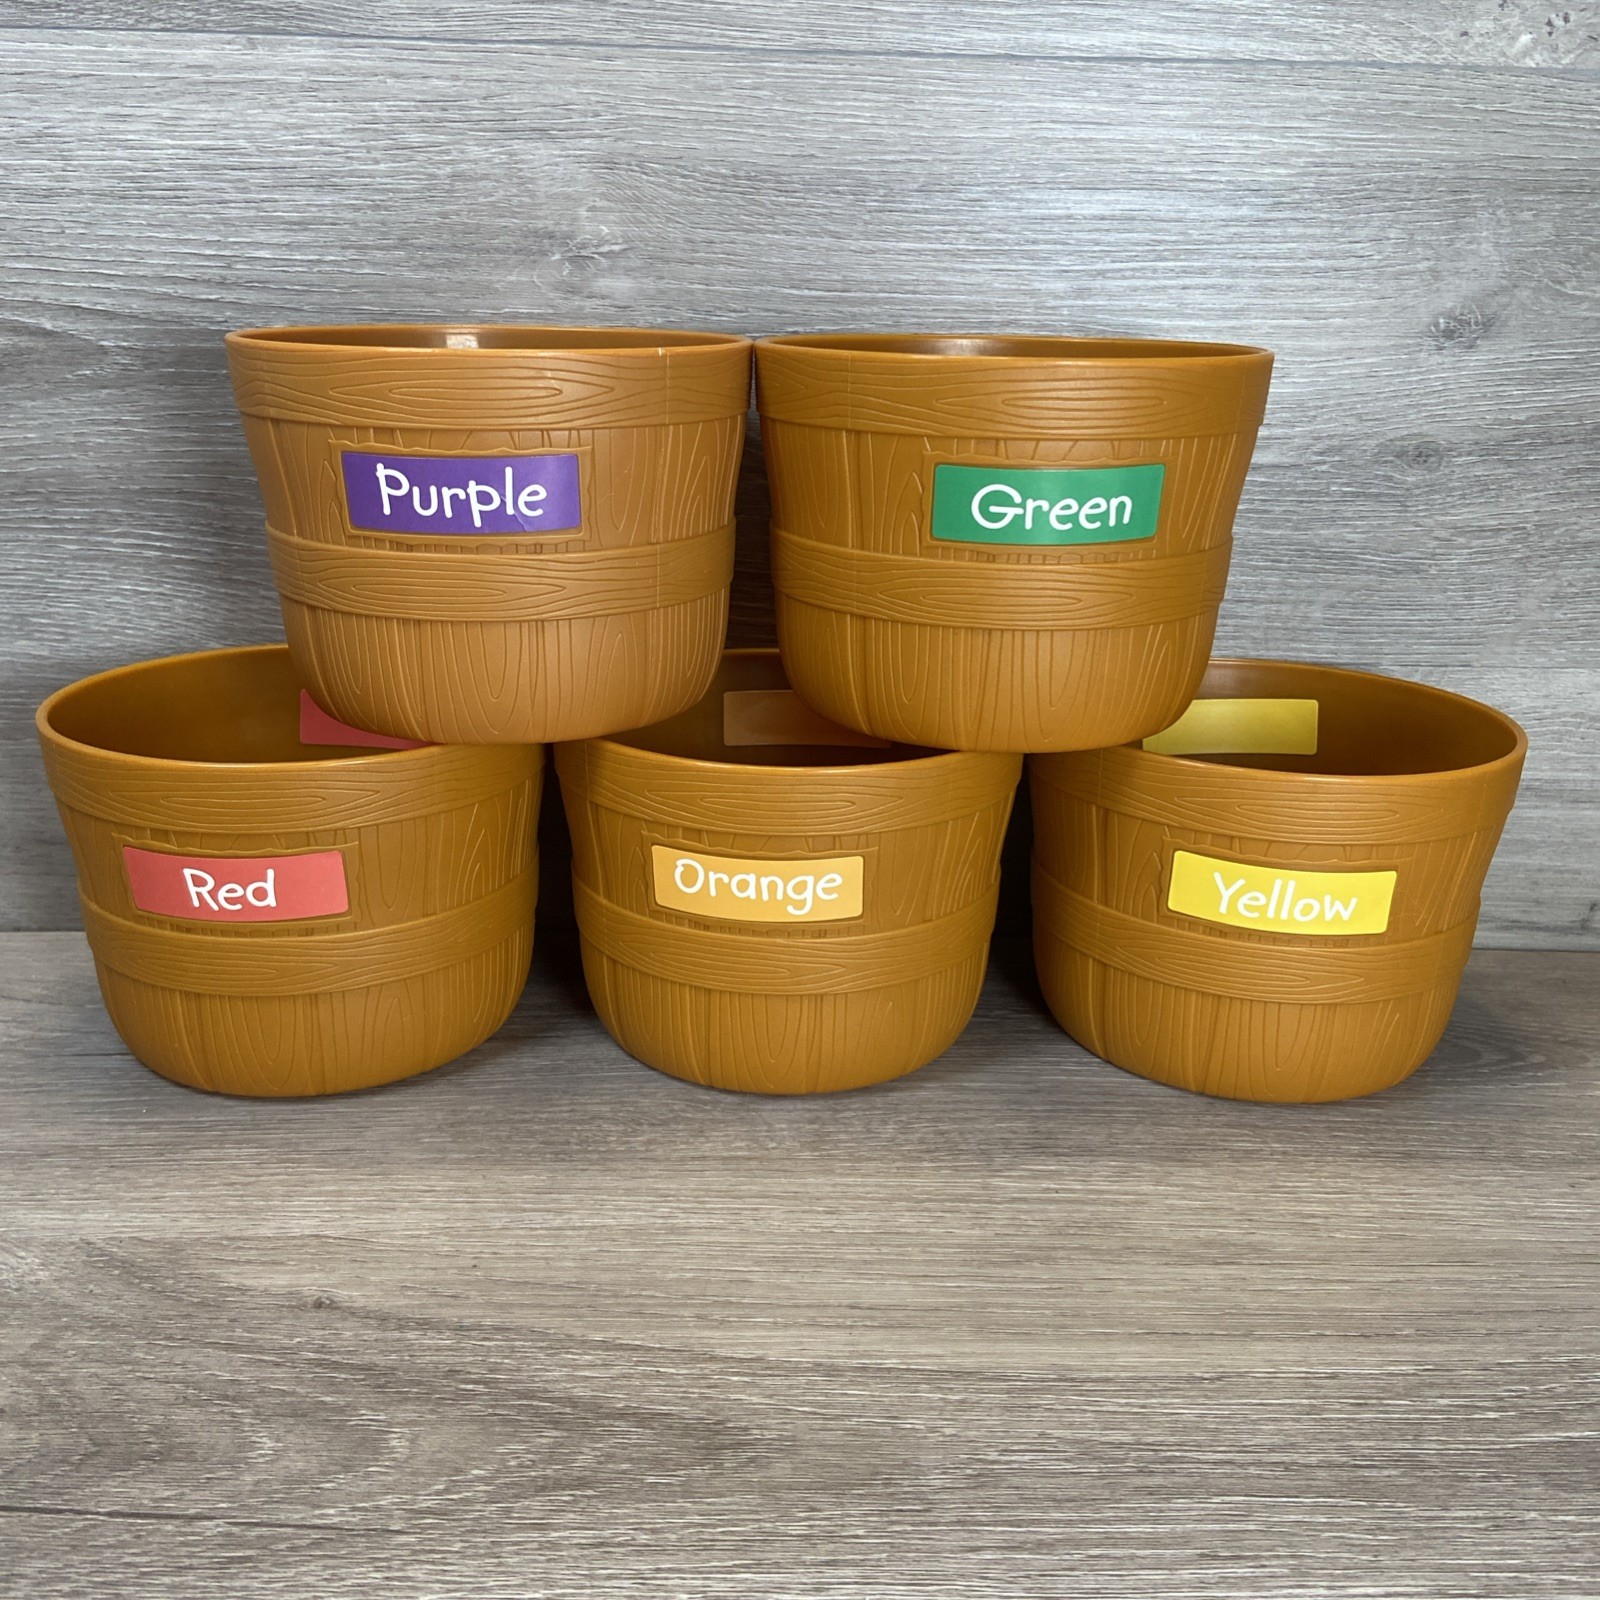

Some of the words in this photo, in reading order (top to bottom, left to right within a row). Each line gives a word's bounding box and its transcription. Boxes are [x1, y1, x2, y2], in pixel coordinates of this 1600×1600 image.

[376, 463, 547, 528] Purple
[971, 484, 1133, 531] Green
[182, 867, 277, 912] Red
[674, 859, 842, 915] Orange
[1213, 872, 1357, 922] Yellow
